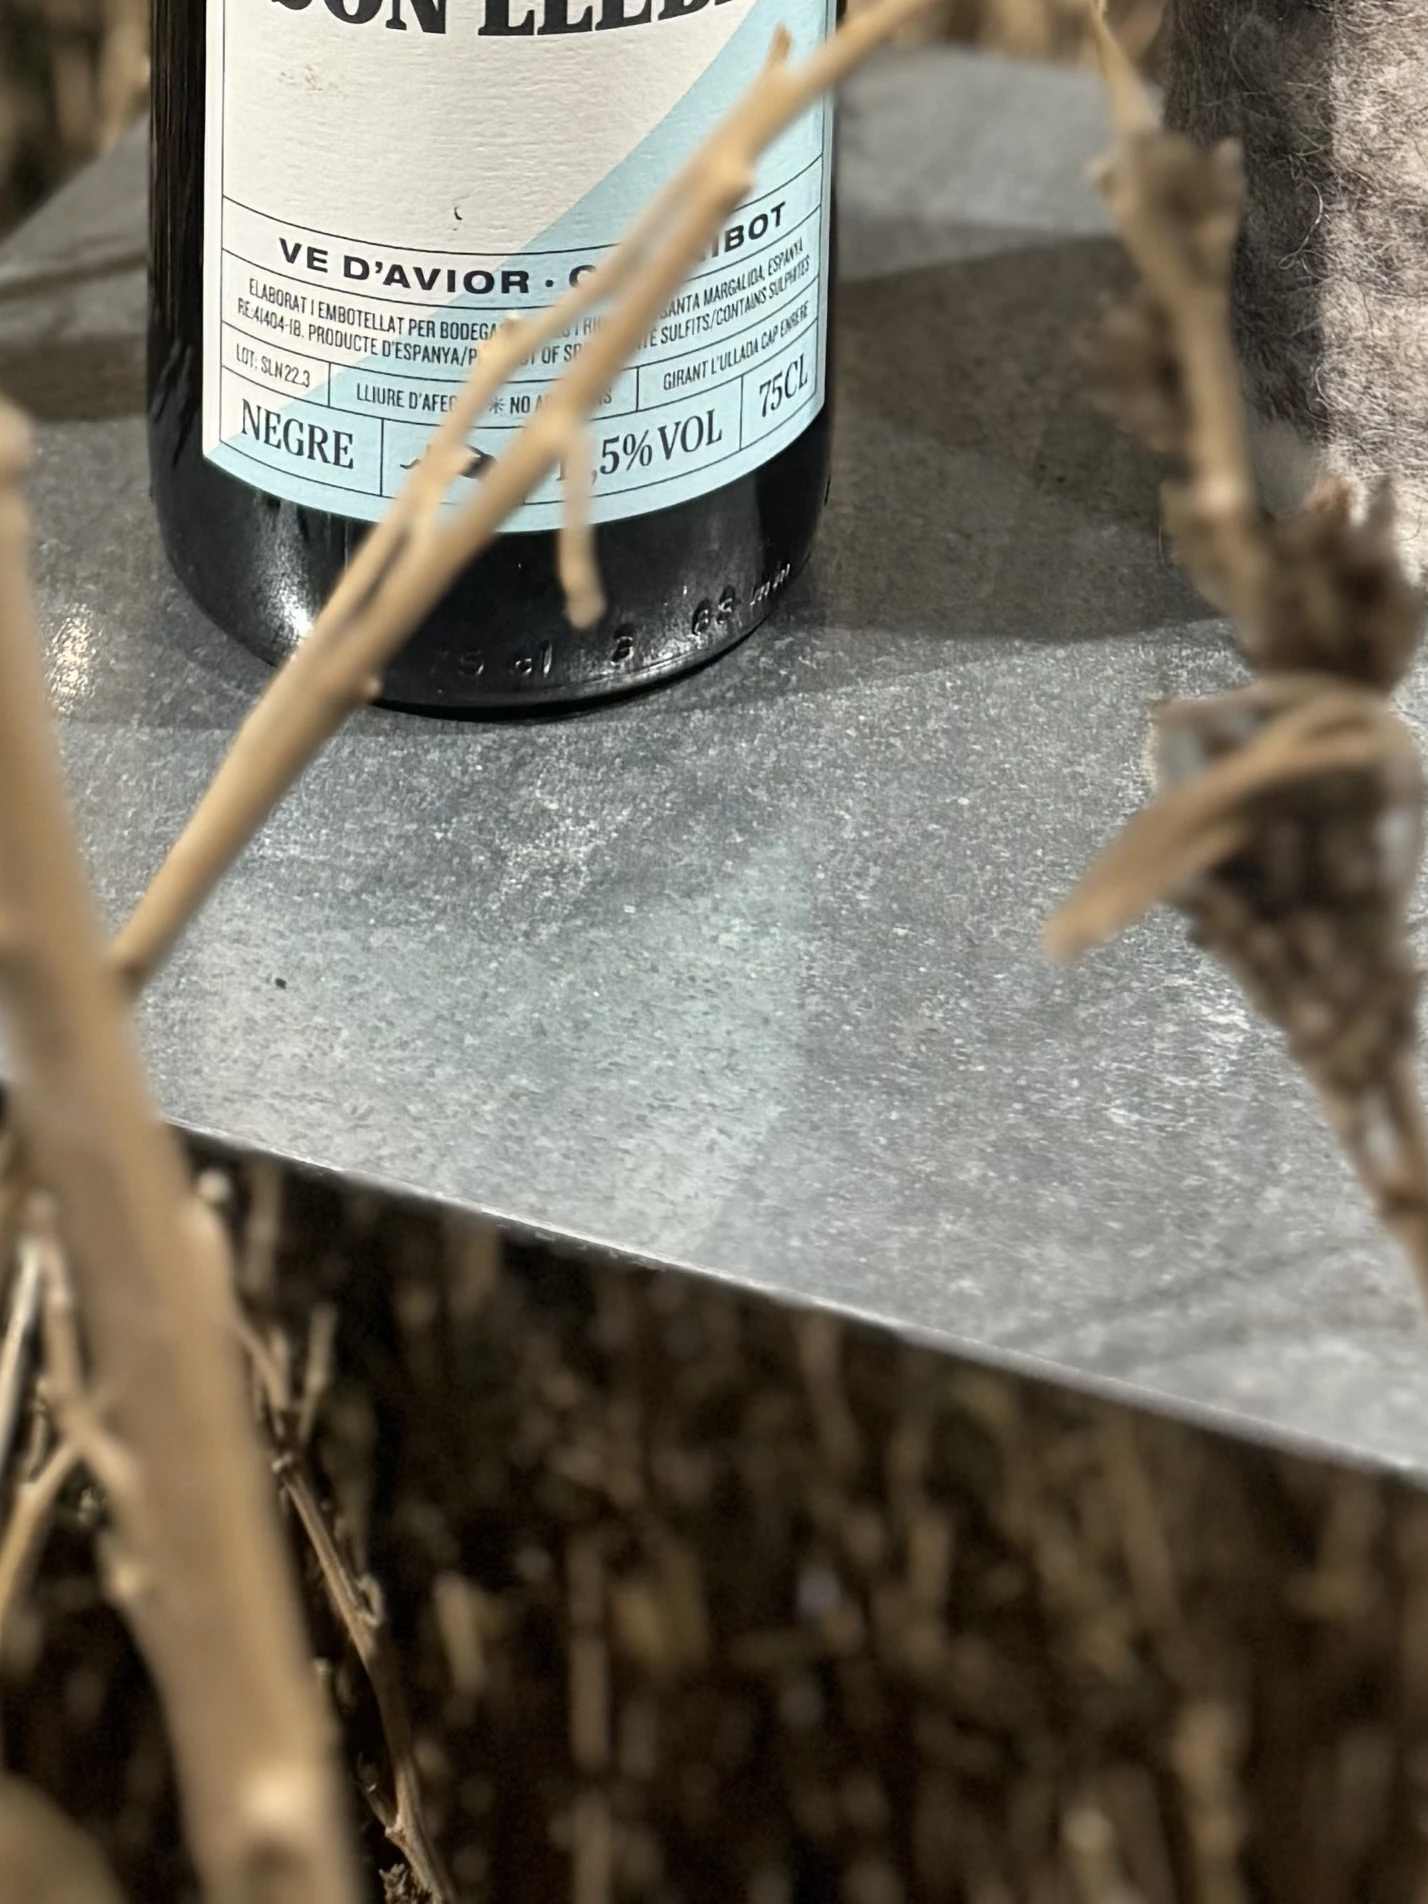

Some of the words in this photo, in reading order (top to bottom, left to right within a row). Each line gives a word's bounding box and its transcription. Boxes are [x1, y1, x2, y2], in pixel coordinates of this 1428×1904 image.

[278, 236, 329, 273] VE
[343, 255, 530, 295] D'AVIOR
[248, 277, 307, 314] ELABORAT
[310, 299, 315, 316] I
[318, 301, 406, 336] EMBOTELLAT
[408, 318, 436, 338] PER
[236, 343, 258, 370] LOT:
[308, 323, 379, 356] PRODUCTE
[541, 346, 560, 365] OF
[663, 359, 710, 391] GIRANT
[760, 323, 779, 351] CAP
[356, 382, 406, 409] LLIURE
[509, 395, 531, 414] NO
[758, 351, 809, 419] 75CL
[241, 397, 354, 470] NEGRE
[658, 408, 723, 462] VOL
